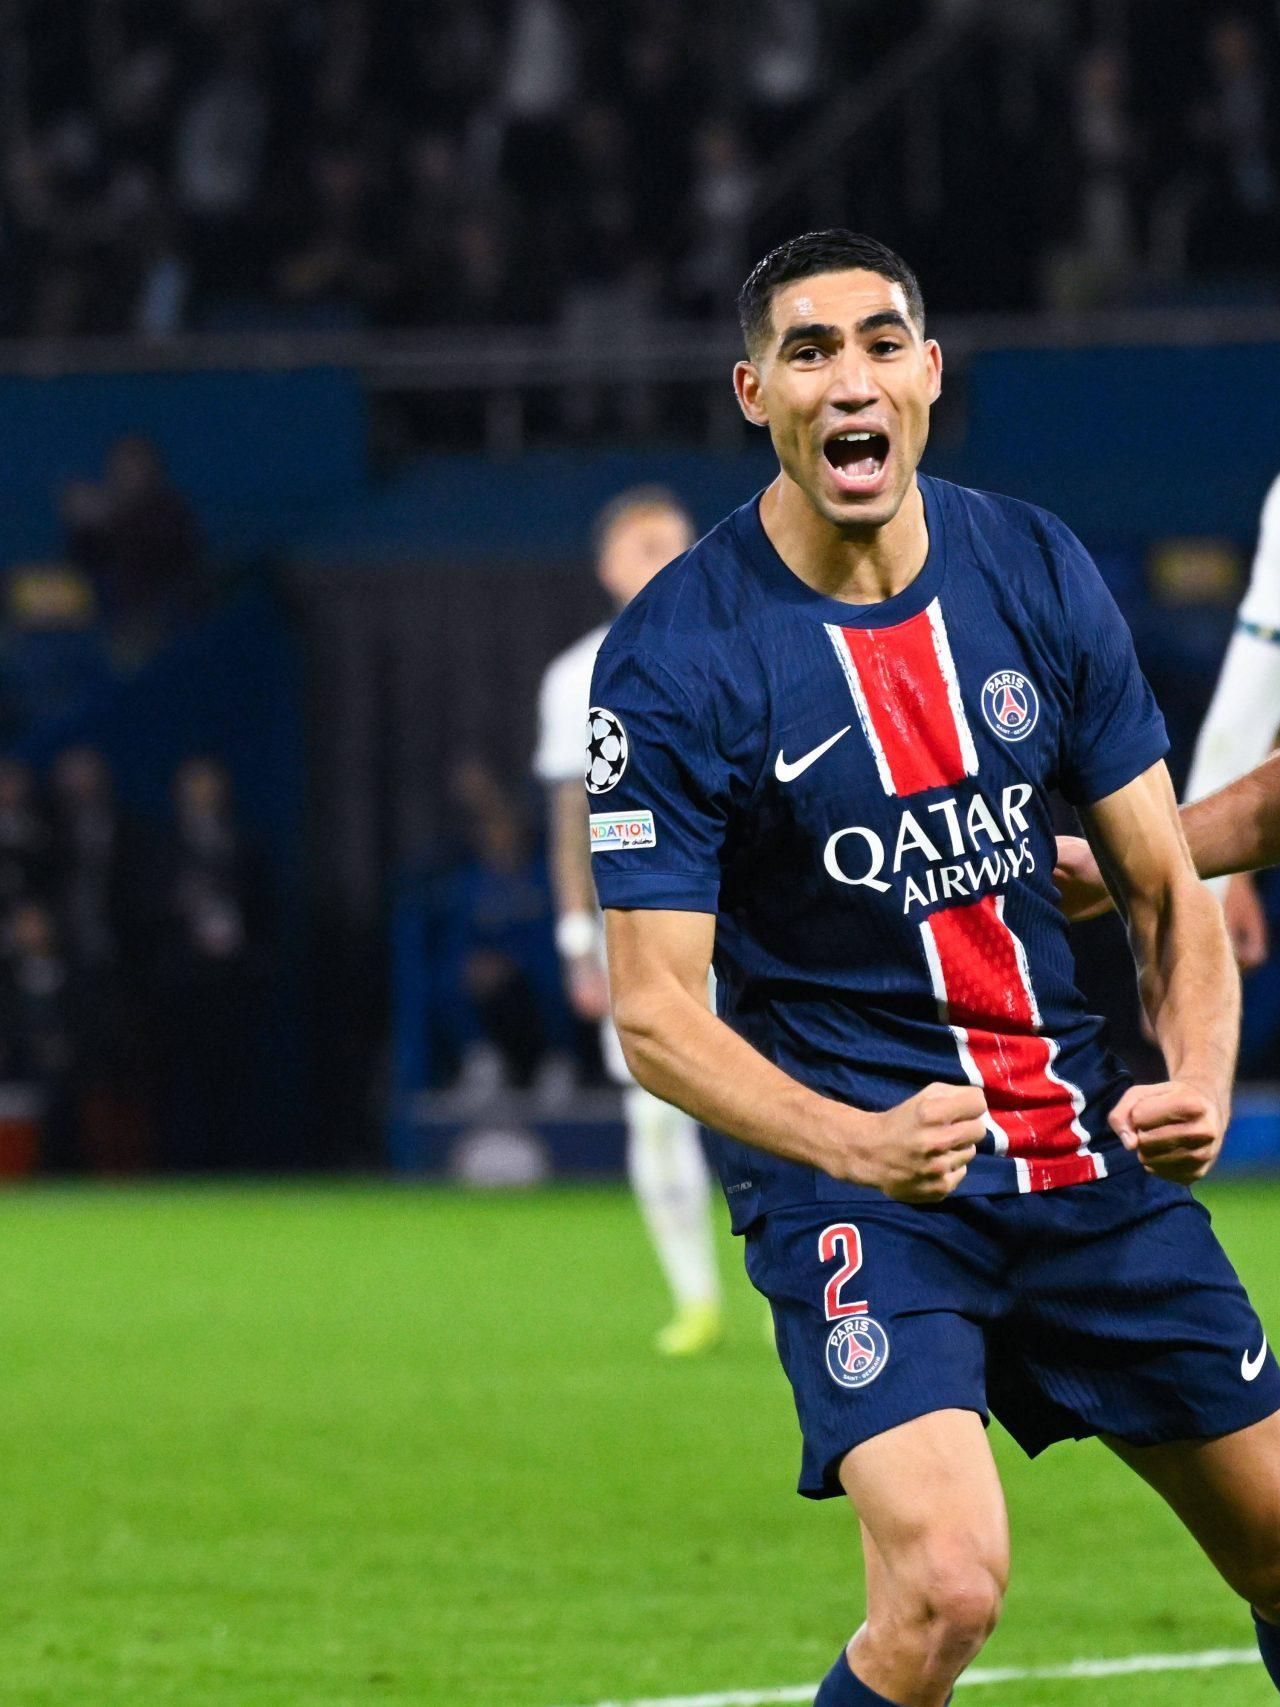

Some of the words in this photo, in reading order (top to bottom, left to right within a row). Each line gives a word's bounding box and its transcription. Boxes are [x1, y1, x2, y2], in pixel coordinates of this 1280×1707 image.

[986, 674, 1025, 694] PARIS
[823, 783, 1033, 893] QATAR
[903, 837, 1035, 915] AIRWAYS
[818, 1223, 868, 1321] 2
[830, 1320, 870, 1347] PARIS
